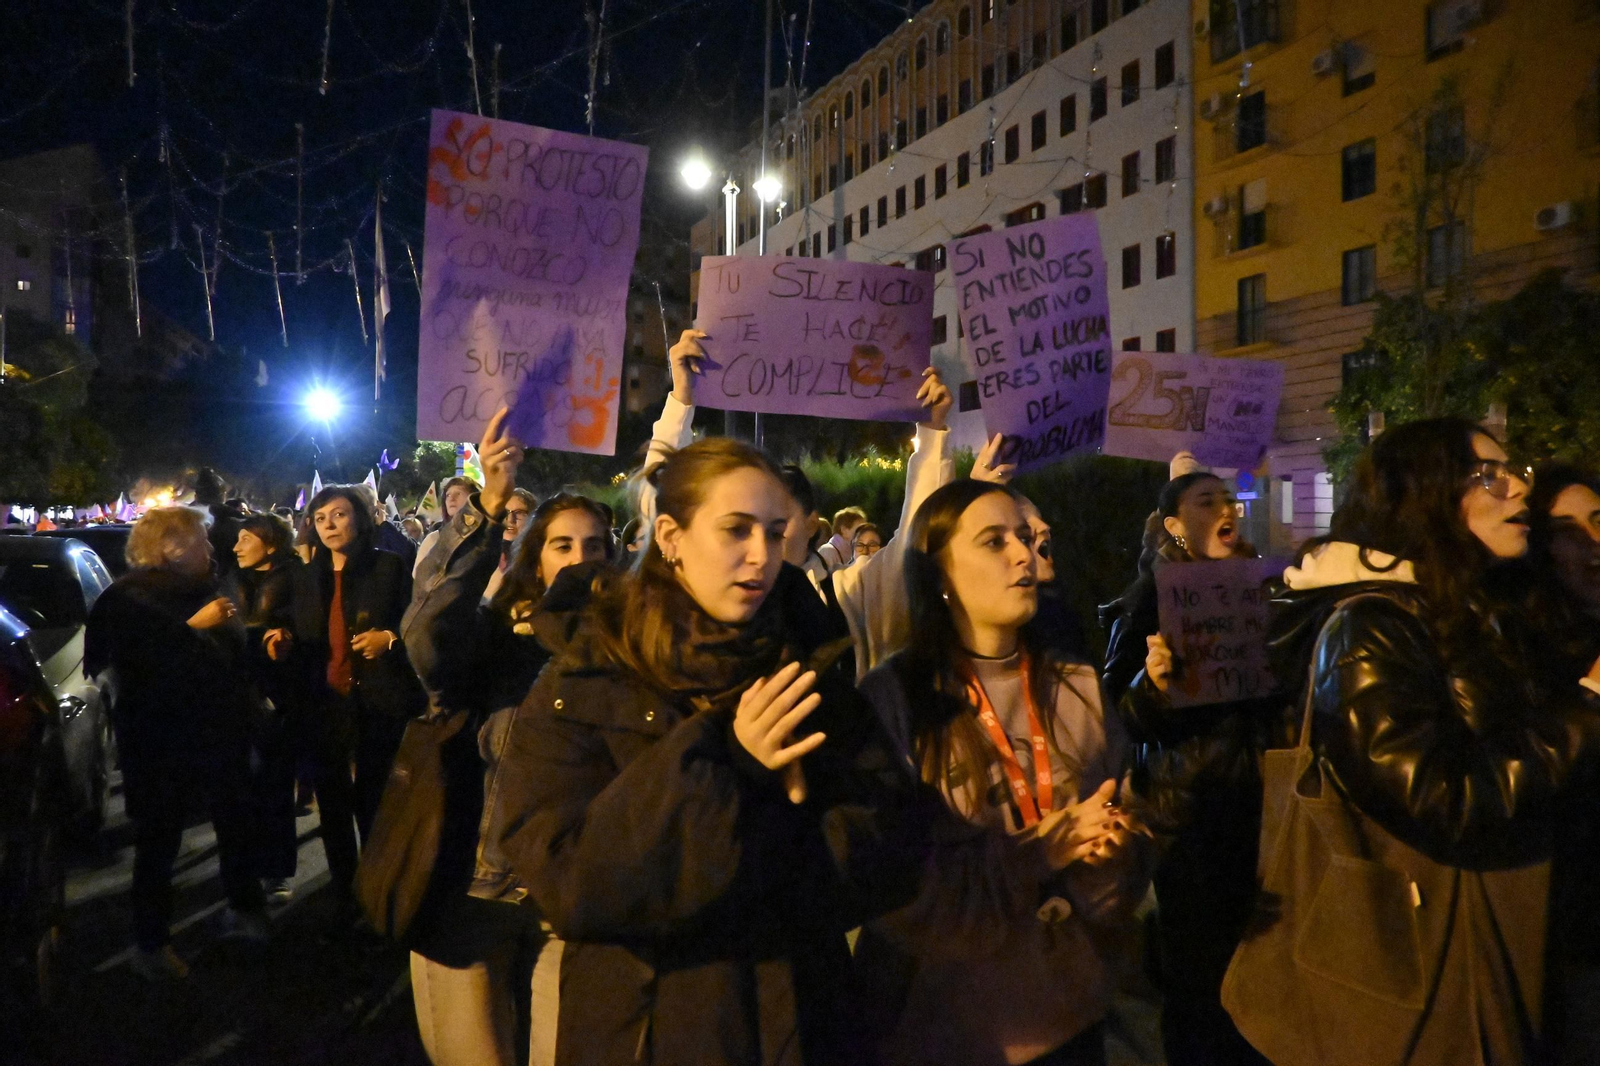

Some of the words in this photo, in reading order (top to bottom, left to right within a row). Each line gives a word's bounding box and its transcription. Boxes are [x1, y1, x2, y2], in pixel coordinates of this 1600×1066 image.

[504, 138, 641, 202] PROTESTO
[444, 184, 558, 238] PORQUE
[572, 204, 625, 247] NO
[954, 241, 985, 277] SI
[1005, 231, 1046, 268] NO
[707, 258, 743, 295] TU
[768, 261, 925, 306] SILENCIO
[962, 249, 1094, 311] ENTIENDES
[502, 318, 542, 348] NO
[719, 312, 761, 344] TE
[802, 311, 888, 345] HACE
[969, 312, 997, 342] EL
[1007, 285, 1092, 327] MOTIVO
[974, 340, 1005, 367] DE
[1019, 331, 1044, 358] LA
[1052, 314, 1109, 350] LUCHA
[462, 348, 573, 387] SUFRIDO
[1048, 349, 1109, 385] PARTE
[1026, 389, 1072, 425] DEL
[1108, 357, 1211, 433] 25N
